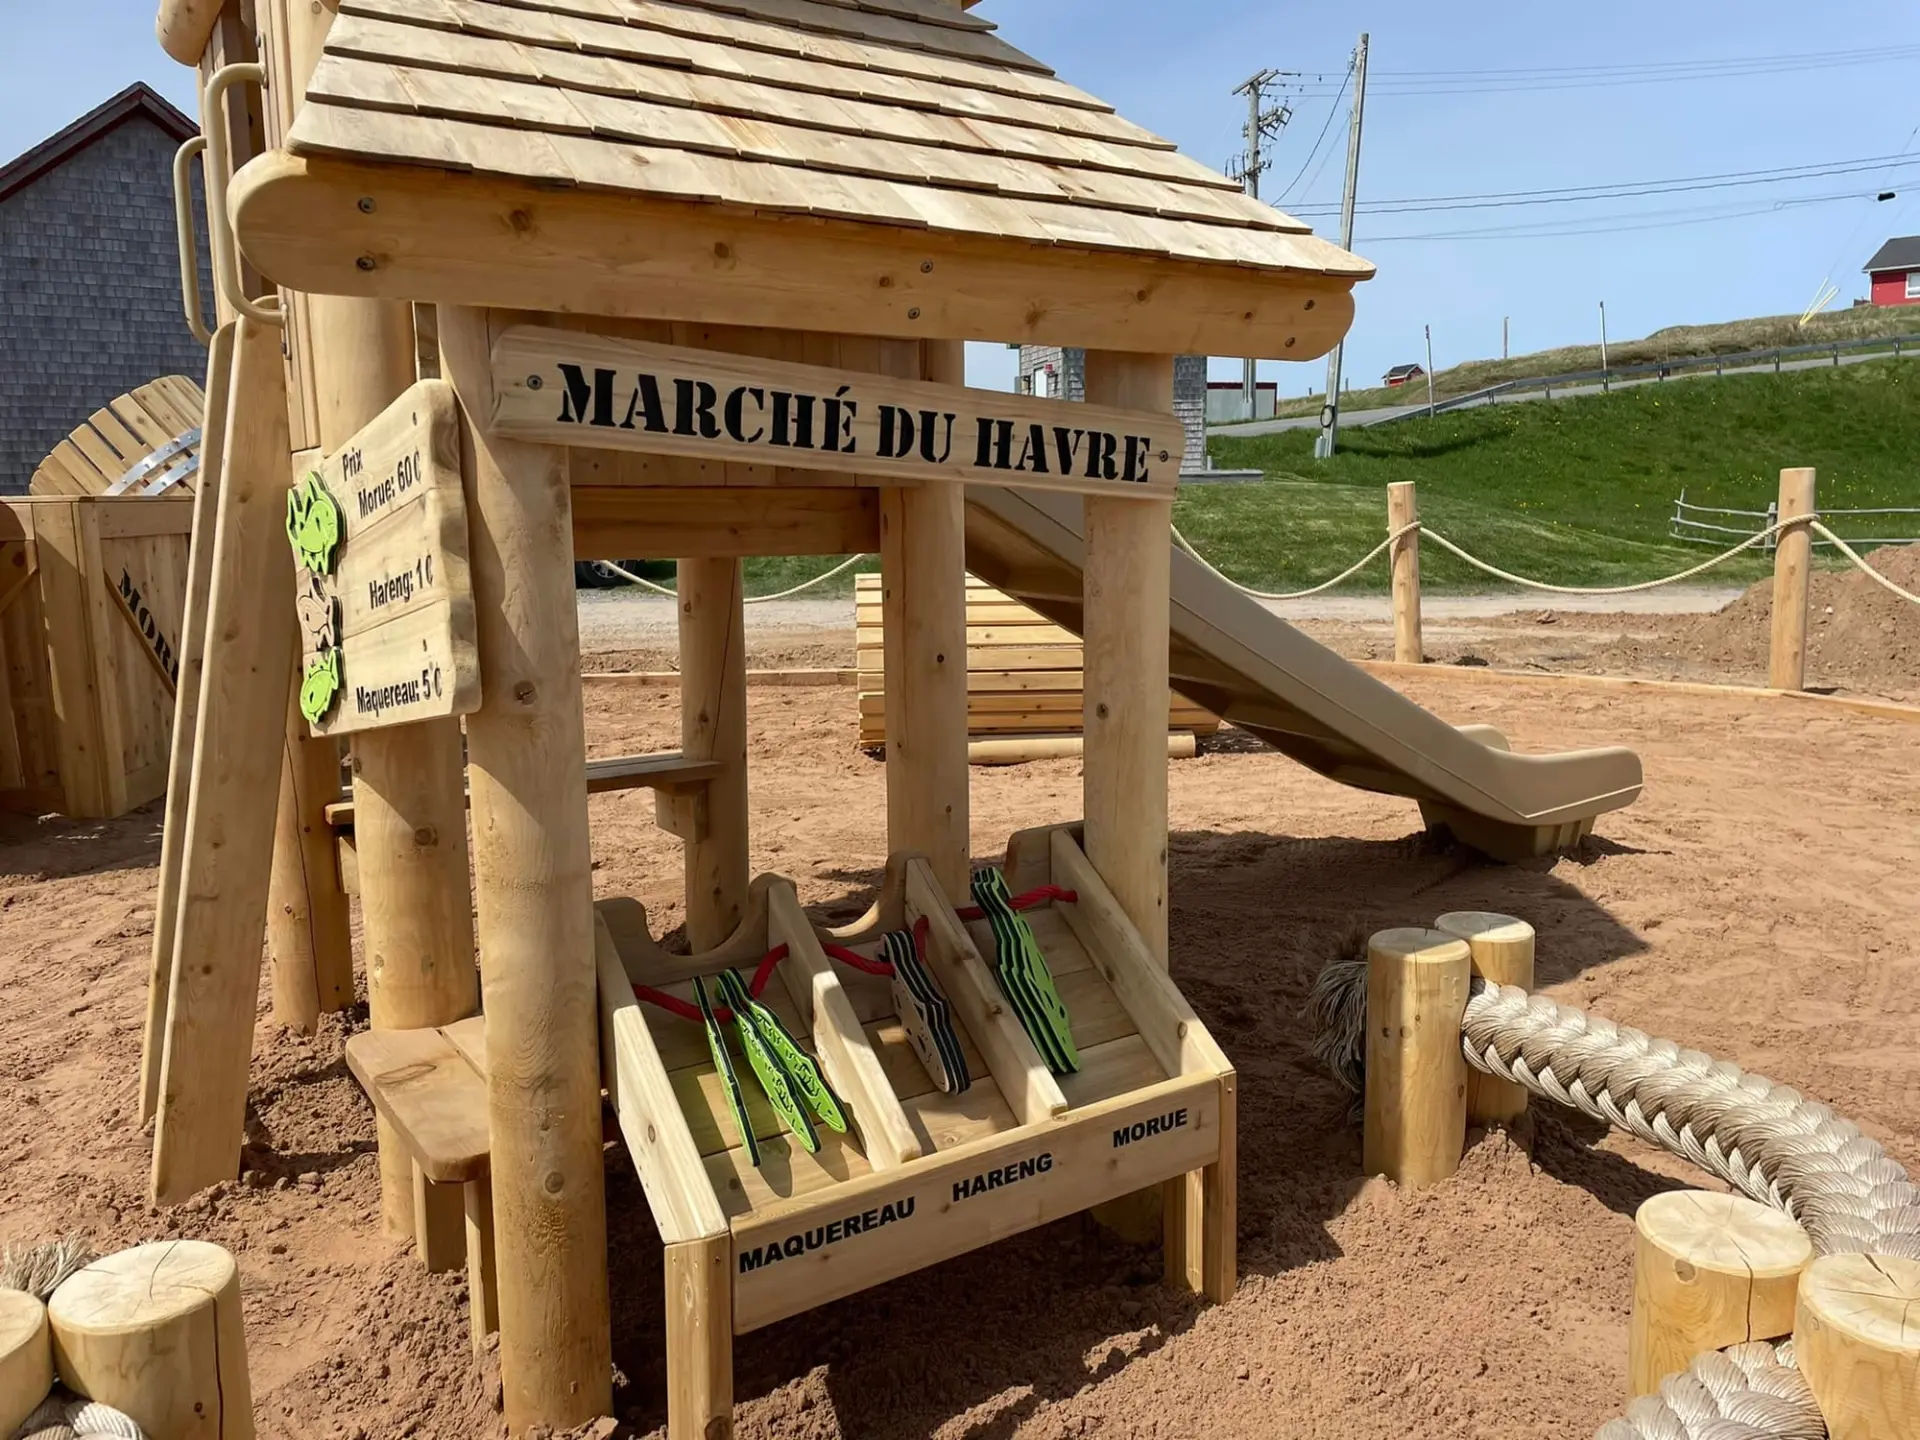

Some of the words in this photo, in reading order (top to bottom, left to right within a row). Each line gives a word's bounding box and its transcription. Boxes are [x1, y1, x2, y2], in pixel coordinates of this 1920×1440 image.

[556, 362, 858, 454] MARCHÉ
[876, 404, 957, 464] DU
[973, 416, 1152, 484] HAVRE
[342, 446, 363, 482] Prix
[358, 475, 396, 519] Morue:
[369, 569, 414, 610] Hareng:
[356, 679, 420, 718] Maquereau:
[1113, 1107, 1188, 1148] MORUE
[952, 1152, 1053, 1202] HARENG
[738, 1196, 916, 1274] MAQUEREAU
